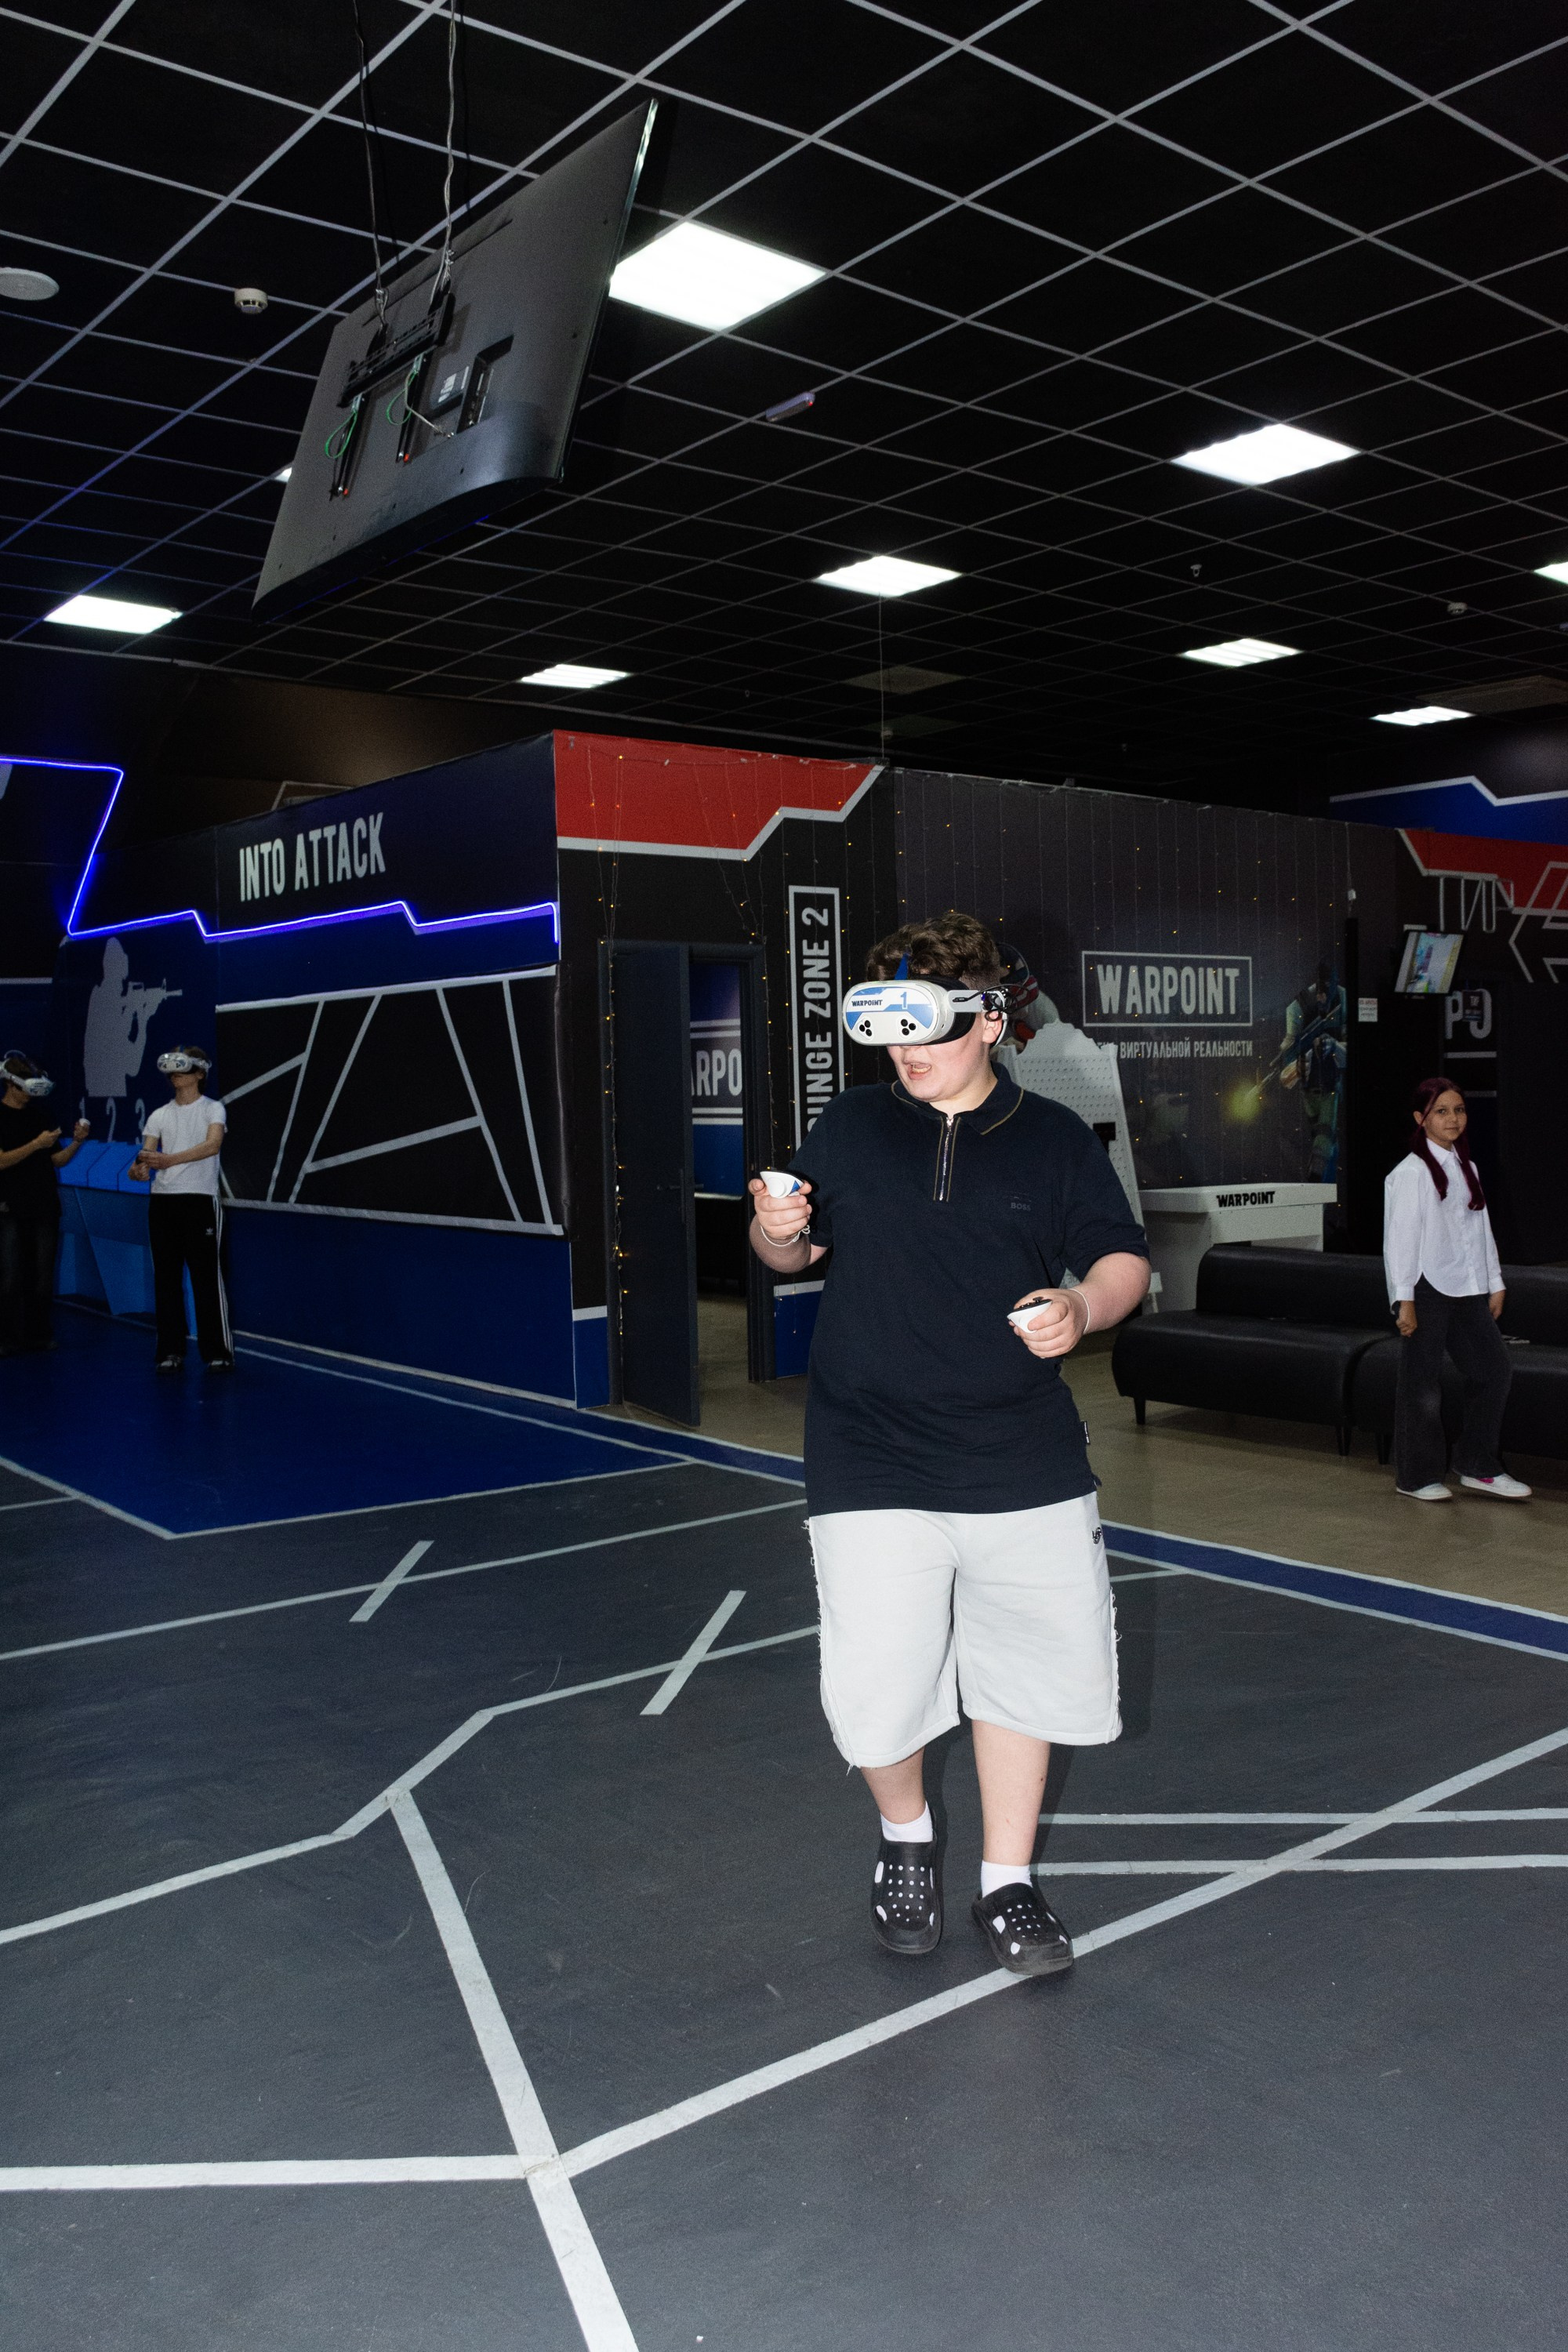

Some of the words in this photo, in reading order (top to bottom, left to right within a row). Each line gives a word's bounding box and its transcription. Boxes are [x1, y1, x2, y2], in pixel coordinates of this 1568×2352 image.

[239, 837, 285, 902] INTO
[294, 811, 387, 891] ATTACK
[801, 906, 829, 927] 2
[801, 938, 832, 1018] ZONE
[900, 991, 908, 1009] 1
[1097, 964, 1240, 1015] WARPOINT
[1120, 1036, 1191, 1059] ВИРТУАЛЬНОЙ
[1194, 1040, 1254, 1058] РЕАЛЬНОСТИ
[691, 1048, 743, 1097] RPO
[804, 1031, 833, 1133] UNGE
[1011, 1202, 1032, 1211] BOSS
